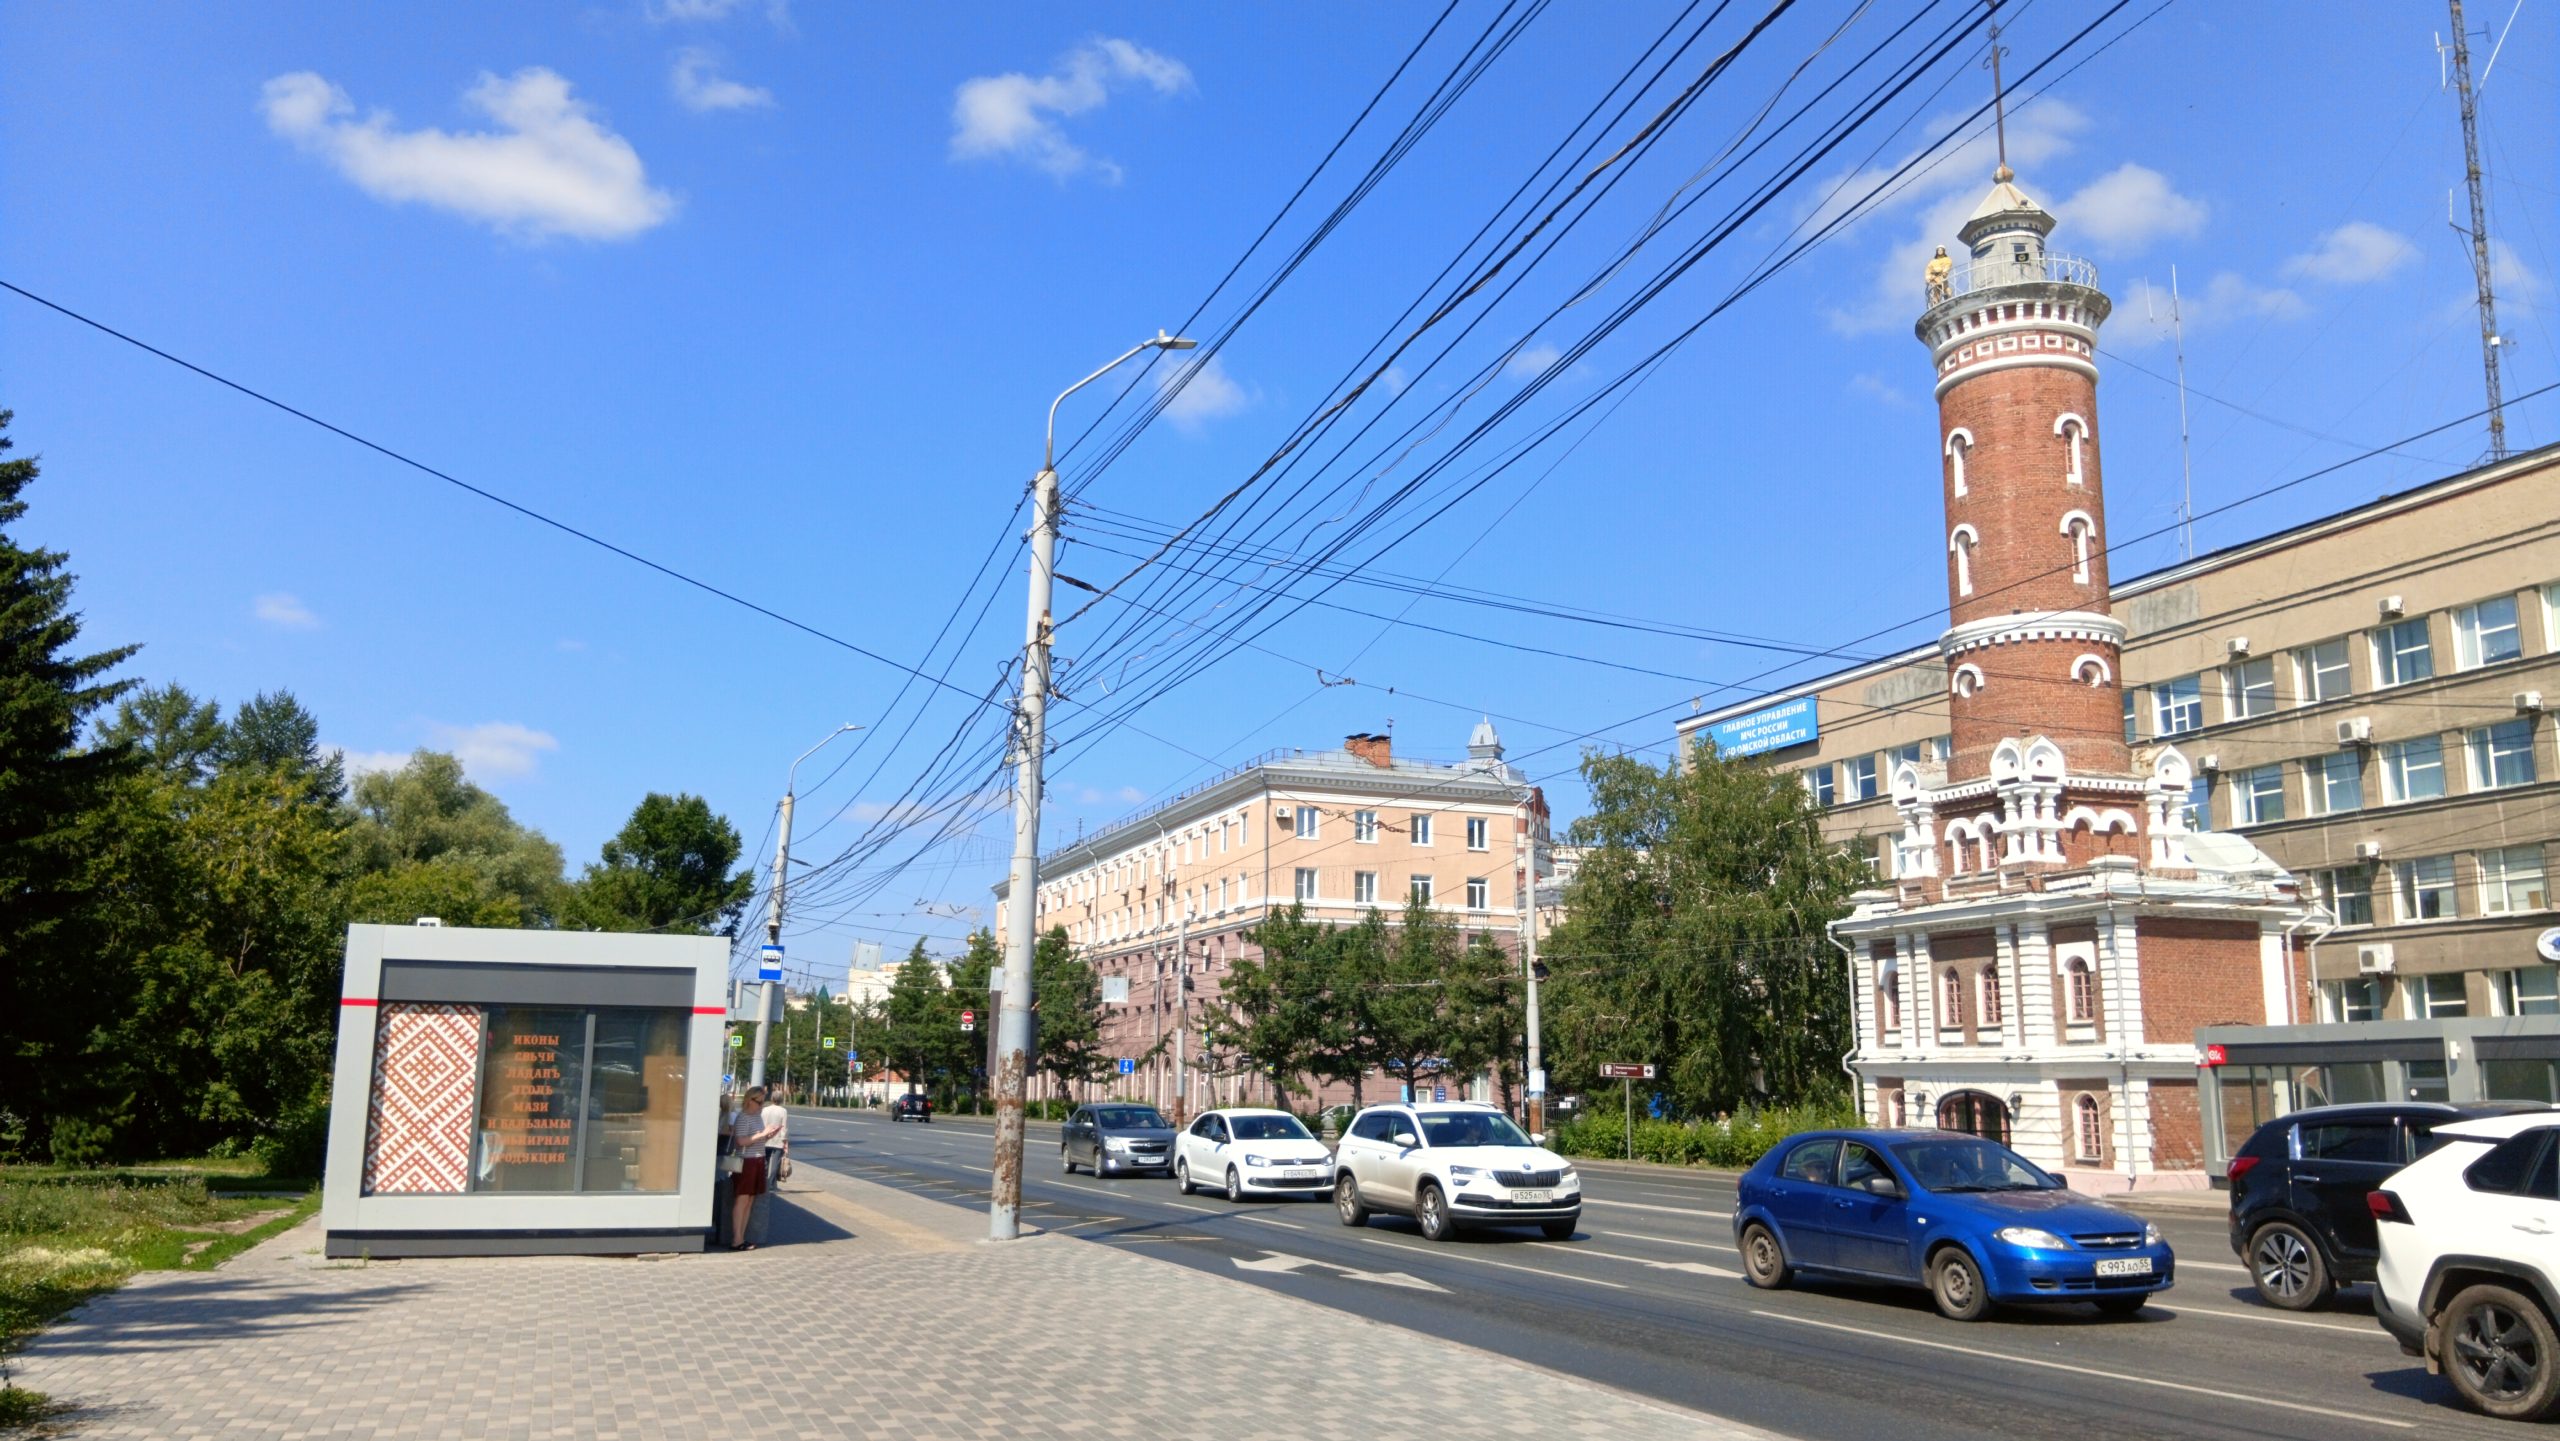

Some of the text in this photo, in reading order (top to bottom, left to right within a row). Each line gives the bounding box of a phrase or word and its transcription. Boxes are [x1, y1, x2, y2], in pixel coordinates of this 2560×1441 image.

[1722, 702, 1807, 734] ГЛАВНОЕ УПРАВЛЕНИЕ
[1740, 720, 1788, 741] МЧС РОССИИ
[1736, 736, 1769, 754] ОМСКОЙ
[1769, 728, 1806, 745] ОБЛАСТИ
[513, 1034, 560, 1046] ИКОНЫ
[511, 1085, 553, 1096] УГОЛЬ
[513, 1102, 549, 1112] МАЗИ
[487, 1118, 572, 1129] И БАЛЬЗАМЫ
